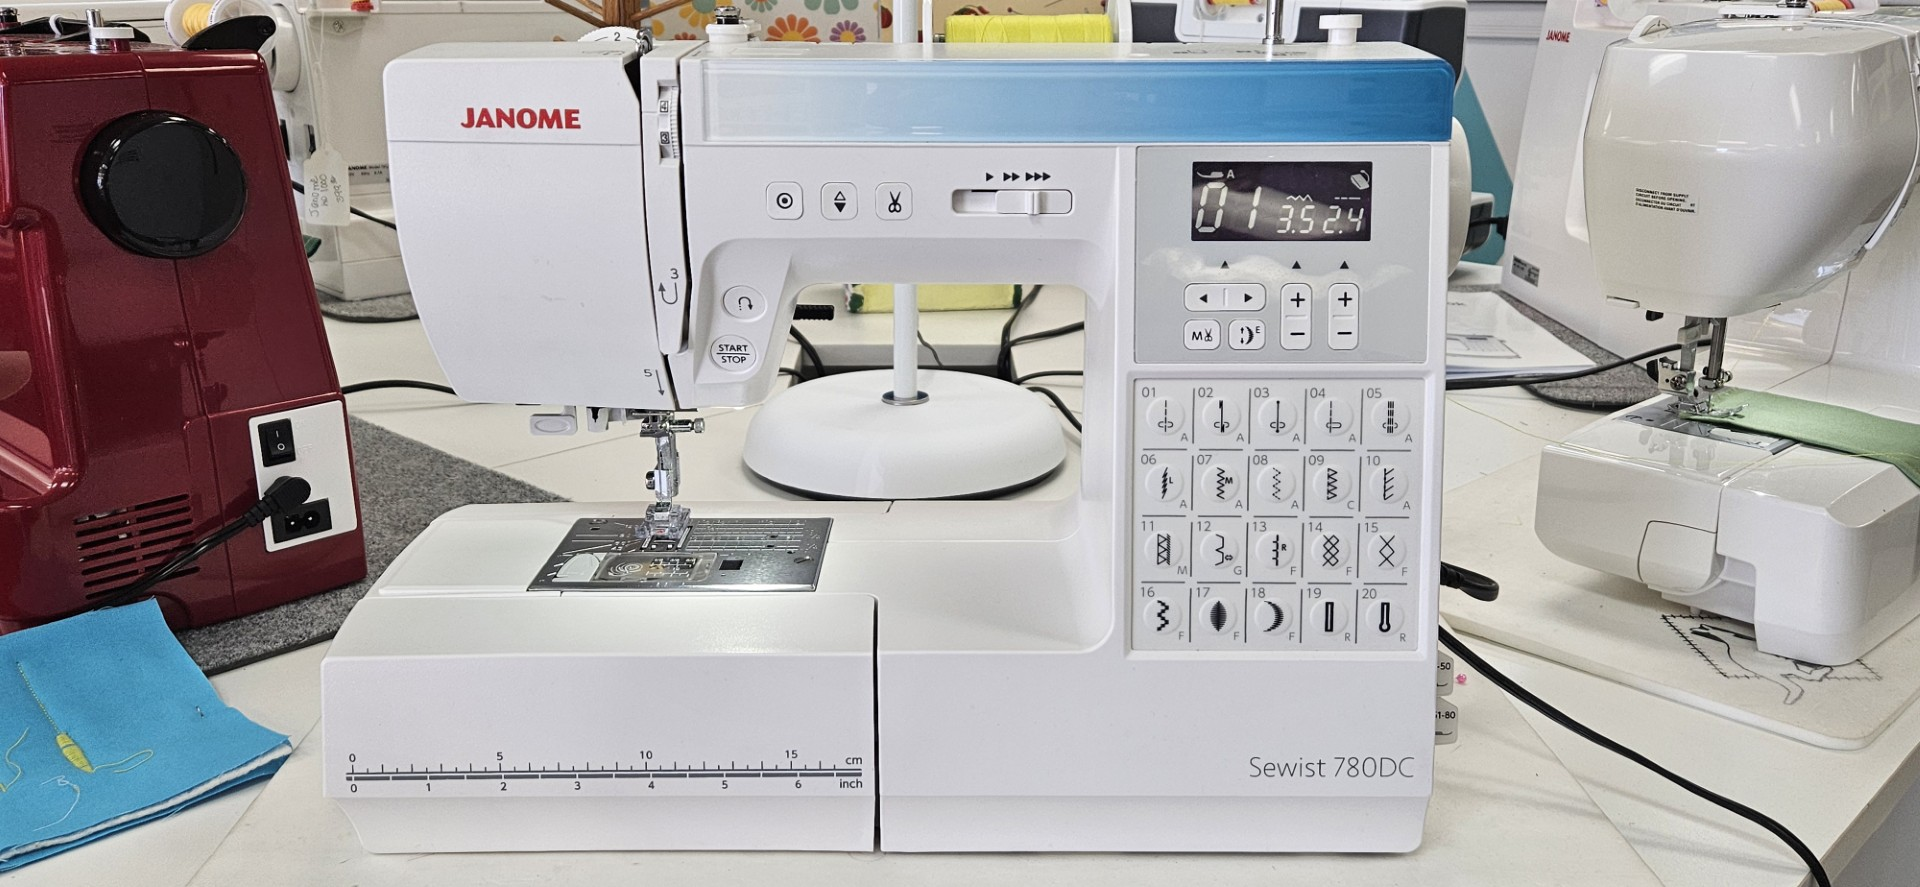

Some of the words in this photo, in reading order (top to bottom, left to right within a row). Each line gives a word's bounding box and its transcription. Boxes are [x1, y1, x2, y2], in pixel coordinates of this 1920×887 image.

[613, 31, 621, 42] 2
[1546, 30, 1570, 42] JANOME
[460, 107, 582, 130] JANOME
[1226, 168, 1235, 180] A
[1195, 182, 1262, 233] 01
[1276, 204, 1315, 234] 3.5
[1321, 205, 1364, 234] 2.4
[670, 267, 680, 280] 3
[1255, 325, 1262, 334] E
[1191, 331, 1204, 342] M
[718, 343, 749, 353] START
[721, 355, 747, 365] STOP
[643, 368, 653, 379] 5
[1141, 386, 1156, 398] 01
[1197, 386, 1214, 398] 02
[1253, 387, 1270, 399] 03
[1309, 387, 1326, 399] 04
[1366, 387, 1383, 399] 05
[1180, 432, 1189, 442] A
[1235, 432, 1245, 442] A
[1292, 432, 1301, 443] A
[1348, 433, 1357, 443] A
[1404, 433, 1413, 443] A
[1140, 453, 1157, 465] 06
[1196, 454, 1213, 466] 07
[1252, 454, 1269, 466] 08
[1308, 454, 1325, 466] 09
[1366, 455, 1381, 467] 10
[1168, 476, 1174, 485] L
[1224, 476, 1234, 486] M
[1179, 499, 1188, 509] A
[1234, 499, 1244, 509] A
[1290, 499, 1299, 509] A
[1346, 500, 1355, 510] C
[1402, 500, 1411, 510] A
[1141, 520, 1154, 532] 11
[1197, 520, 1212, 532] 12
[1252, 520, 1267, 533] 13
[1308, 521, 1323, 533] 14
[1364, 521, 1379, 533] 15
[1281, 543, 1288, 553] R
[1177, 565, 1188, 575] M
[1233, 565, 1243, 576] G
[1290, 566, 1297, 576] F
[1346, 566, 1353, 576] F
[1401, 566, 1408, 577] F
[1140, 586, 1156, 598] 16
[1196, 586, 1211, 598] 17
[1251, 586, 1266, 599] 18
[1306, 587, 1322, 599] 19
[1361, 587, 1377, 600] 20
[1178, 630, 1185, 641] F
[1233, 631, 1240, 641] F
[1288, 631, 1295, 641] F
[1344, 632, 1351, 642] R
[1399, 632, 1407, 643] R
[348, 753, 357, 763] 0
[496, 751, 504, 761] 5
[639, 750, 653, 760] 10
[785, 749, 799, 759] 15
[845, 756, 863, 765] cm
[1249, 756, 1327, 778] Sewist
[1334, 756, 1416, 778] 780DC
[350, 783, 358, 793] 0
[500, 781, 508, 792] 2
[574, 780, 582, 791] 3
[647, 780, 655, 790] 4
[721, 779, 729, 790] 5
[794, 779, 802, 789] 6
[839, 778, 863, 789] inch
